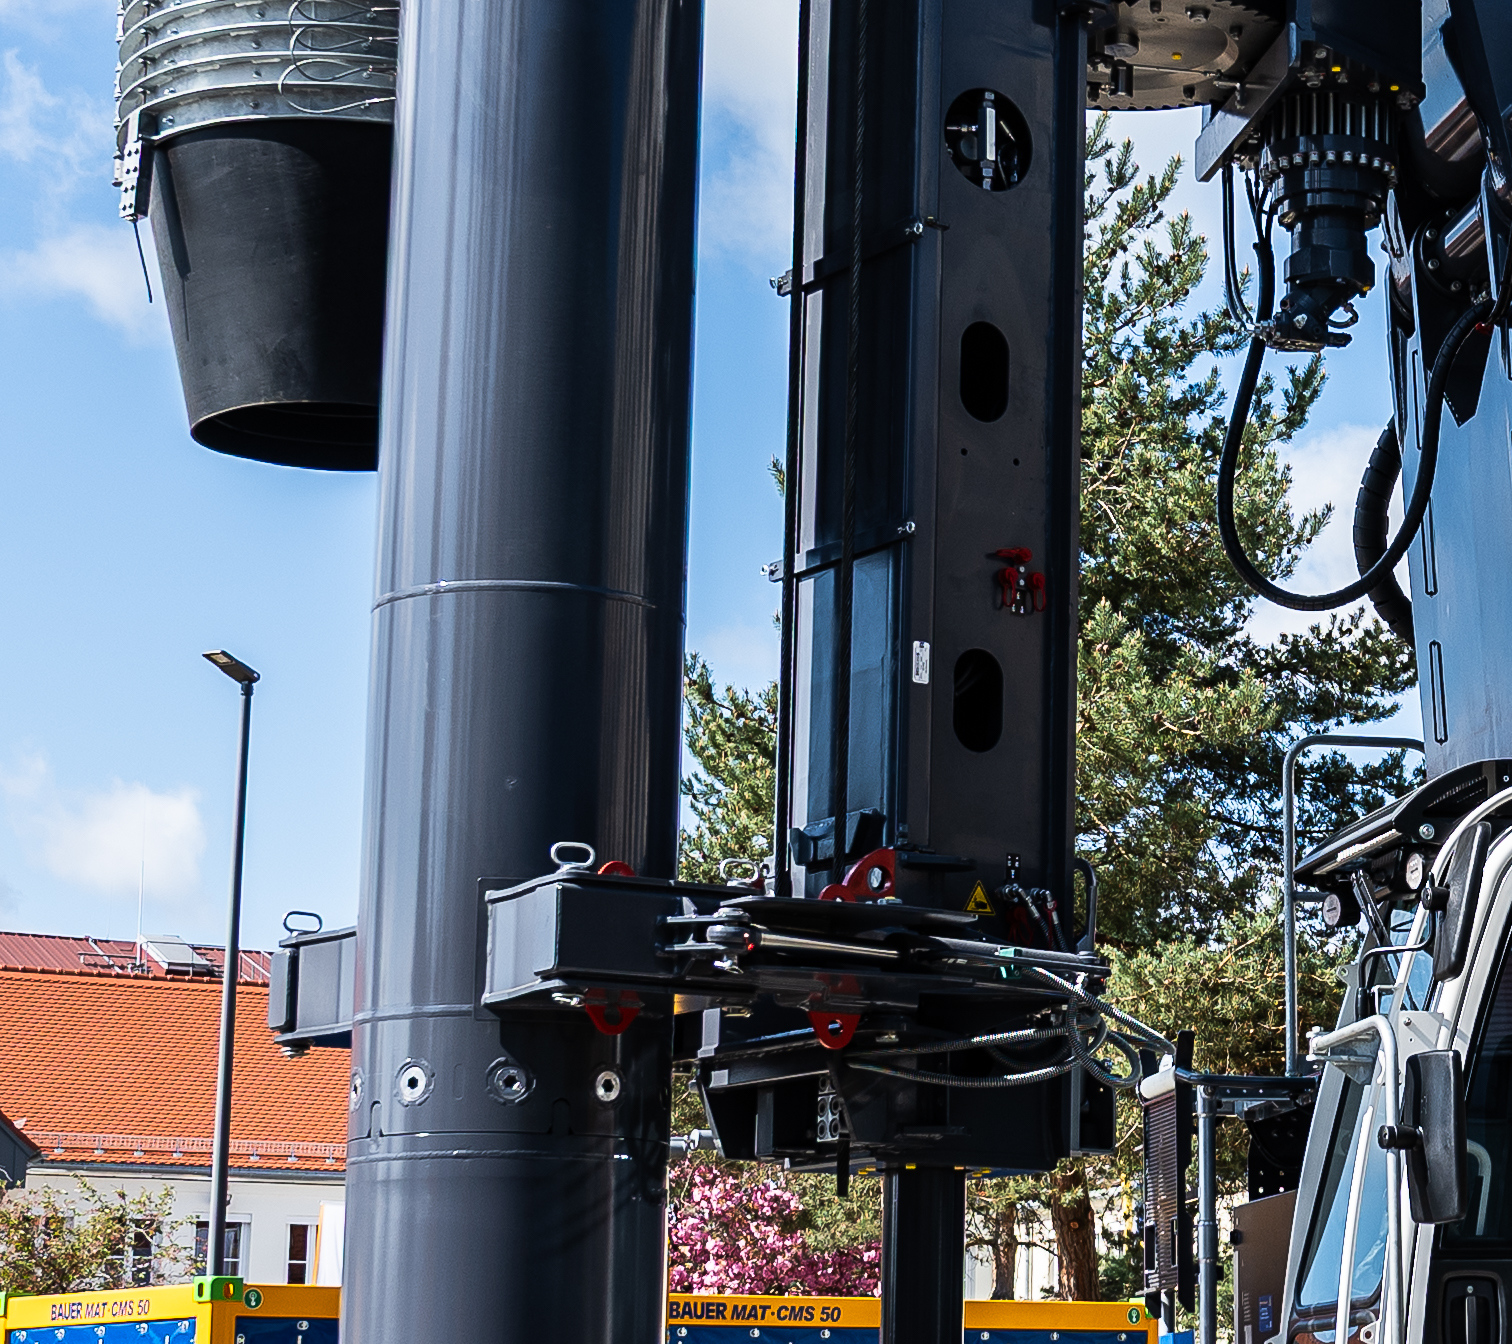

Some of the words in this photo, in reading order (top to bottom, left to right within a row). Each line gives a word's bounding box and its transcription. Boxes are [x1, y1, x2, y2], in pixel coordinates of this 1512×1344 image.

[51, 1302, 82, 1321] BAUER
[137, 1299, 150, 1315] 50
[669, 1301, 727, 1320] BAUER
[820, 1307, 841, 1322] 50
